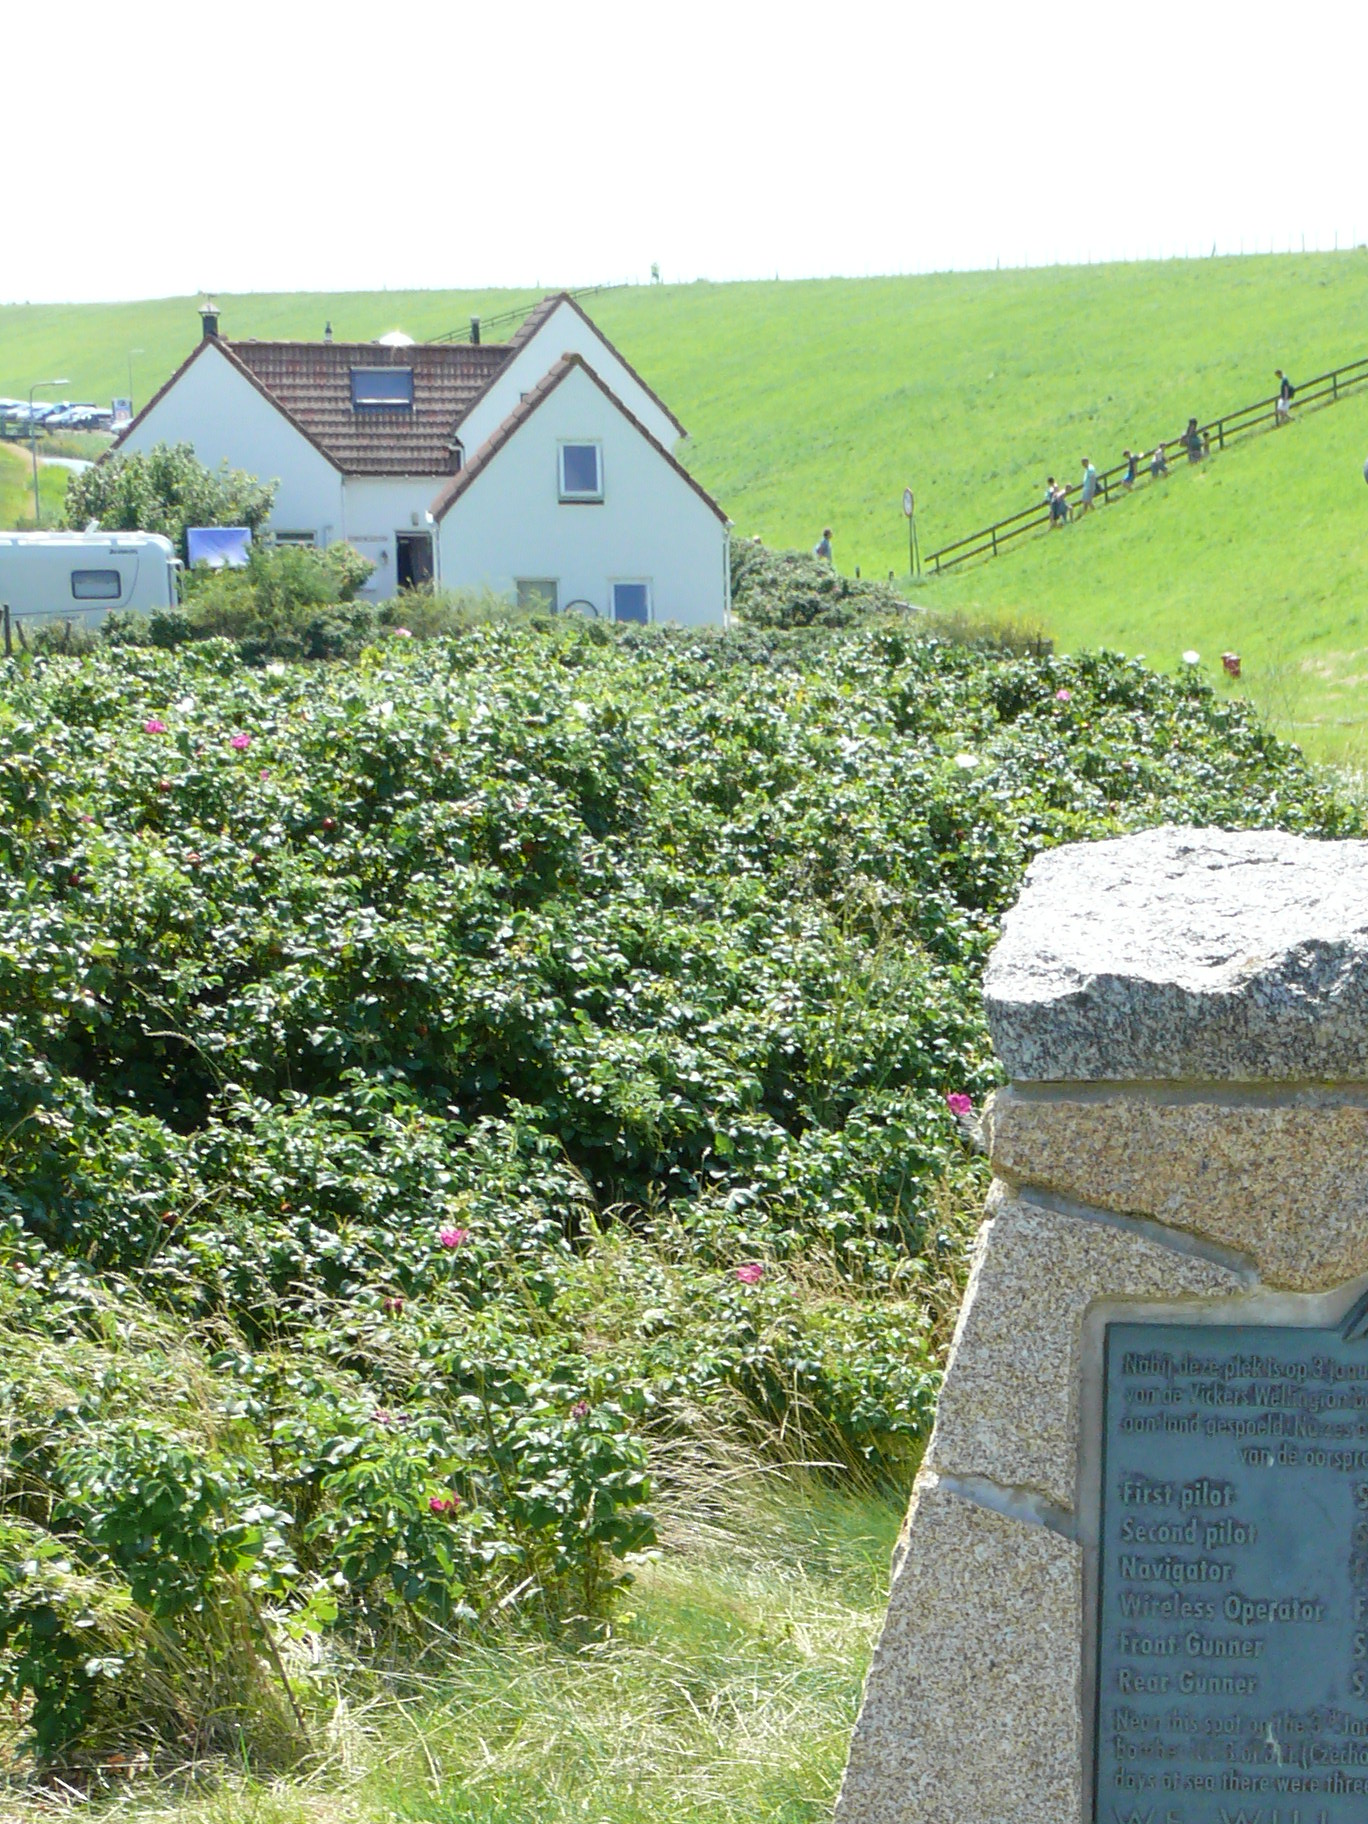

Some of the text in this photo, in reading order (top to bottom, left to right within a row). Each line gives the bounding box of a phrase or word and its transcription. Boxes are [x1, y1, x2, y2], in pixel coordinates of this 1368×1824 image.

[1124, 1353, 1173, 1380] Nabij
[1179, 1356, 1219, 1376] deze
[1224, 1357, 1266, 1381] plek
[1269, 1358, 1282, 1378] is
[1286, 1363, 1307, 1384] op
[1313, 1359, 1323, 1378] 3
[1127, 1388, 1155, 1405] van
[1164, 1385, 1182, 1405] de
[1191, 1382, 1247, 1406] Vickers
[1124, 1417, 1155, 1433] aan
[1163, 1413, 1200, 1433] land
[1240, 1449, 1269, 1466] van
[1278, 1443, 1298, 1466] de
[1122, 1481, 1172, 1507] First
[1181, 1481, 1235, 1512] pilot
[1121, 1518, 1198, 1543] Second
[1207, 1519, 1259, 1549] pilot
[1120, 1555, 1233, 1587] Navigator
[1120, 1592, 1216, 1619] Wireless
[1225, 1595, 1325, 1626] Operator
[1120, 1631, 1176, 1655] Front
[1186, 1632, 1265, 1658] Gunner
[1119, 1668, 1169, 1694] Rear
[1179, 1670, 1258, 1695] Gunner
[1114, 1708, 1161, 1733] Near
[1205, 1714, 1242, 1737] spot
[1115, 1766, 1155, 1792] days
[1186, 1774, 1215, 1791] sea
[1222, 1769, 1271, 1793] there
[1276, 1775, 1320, 1793] were
